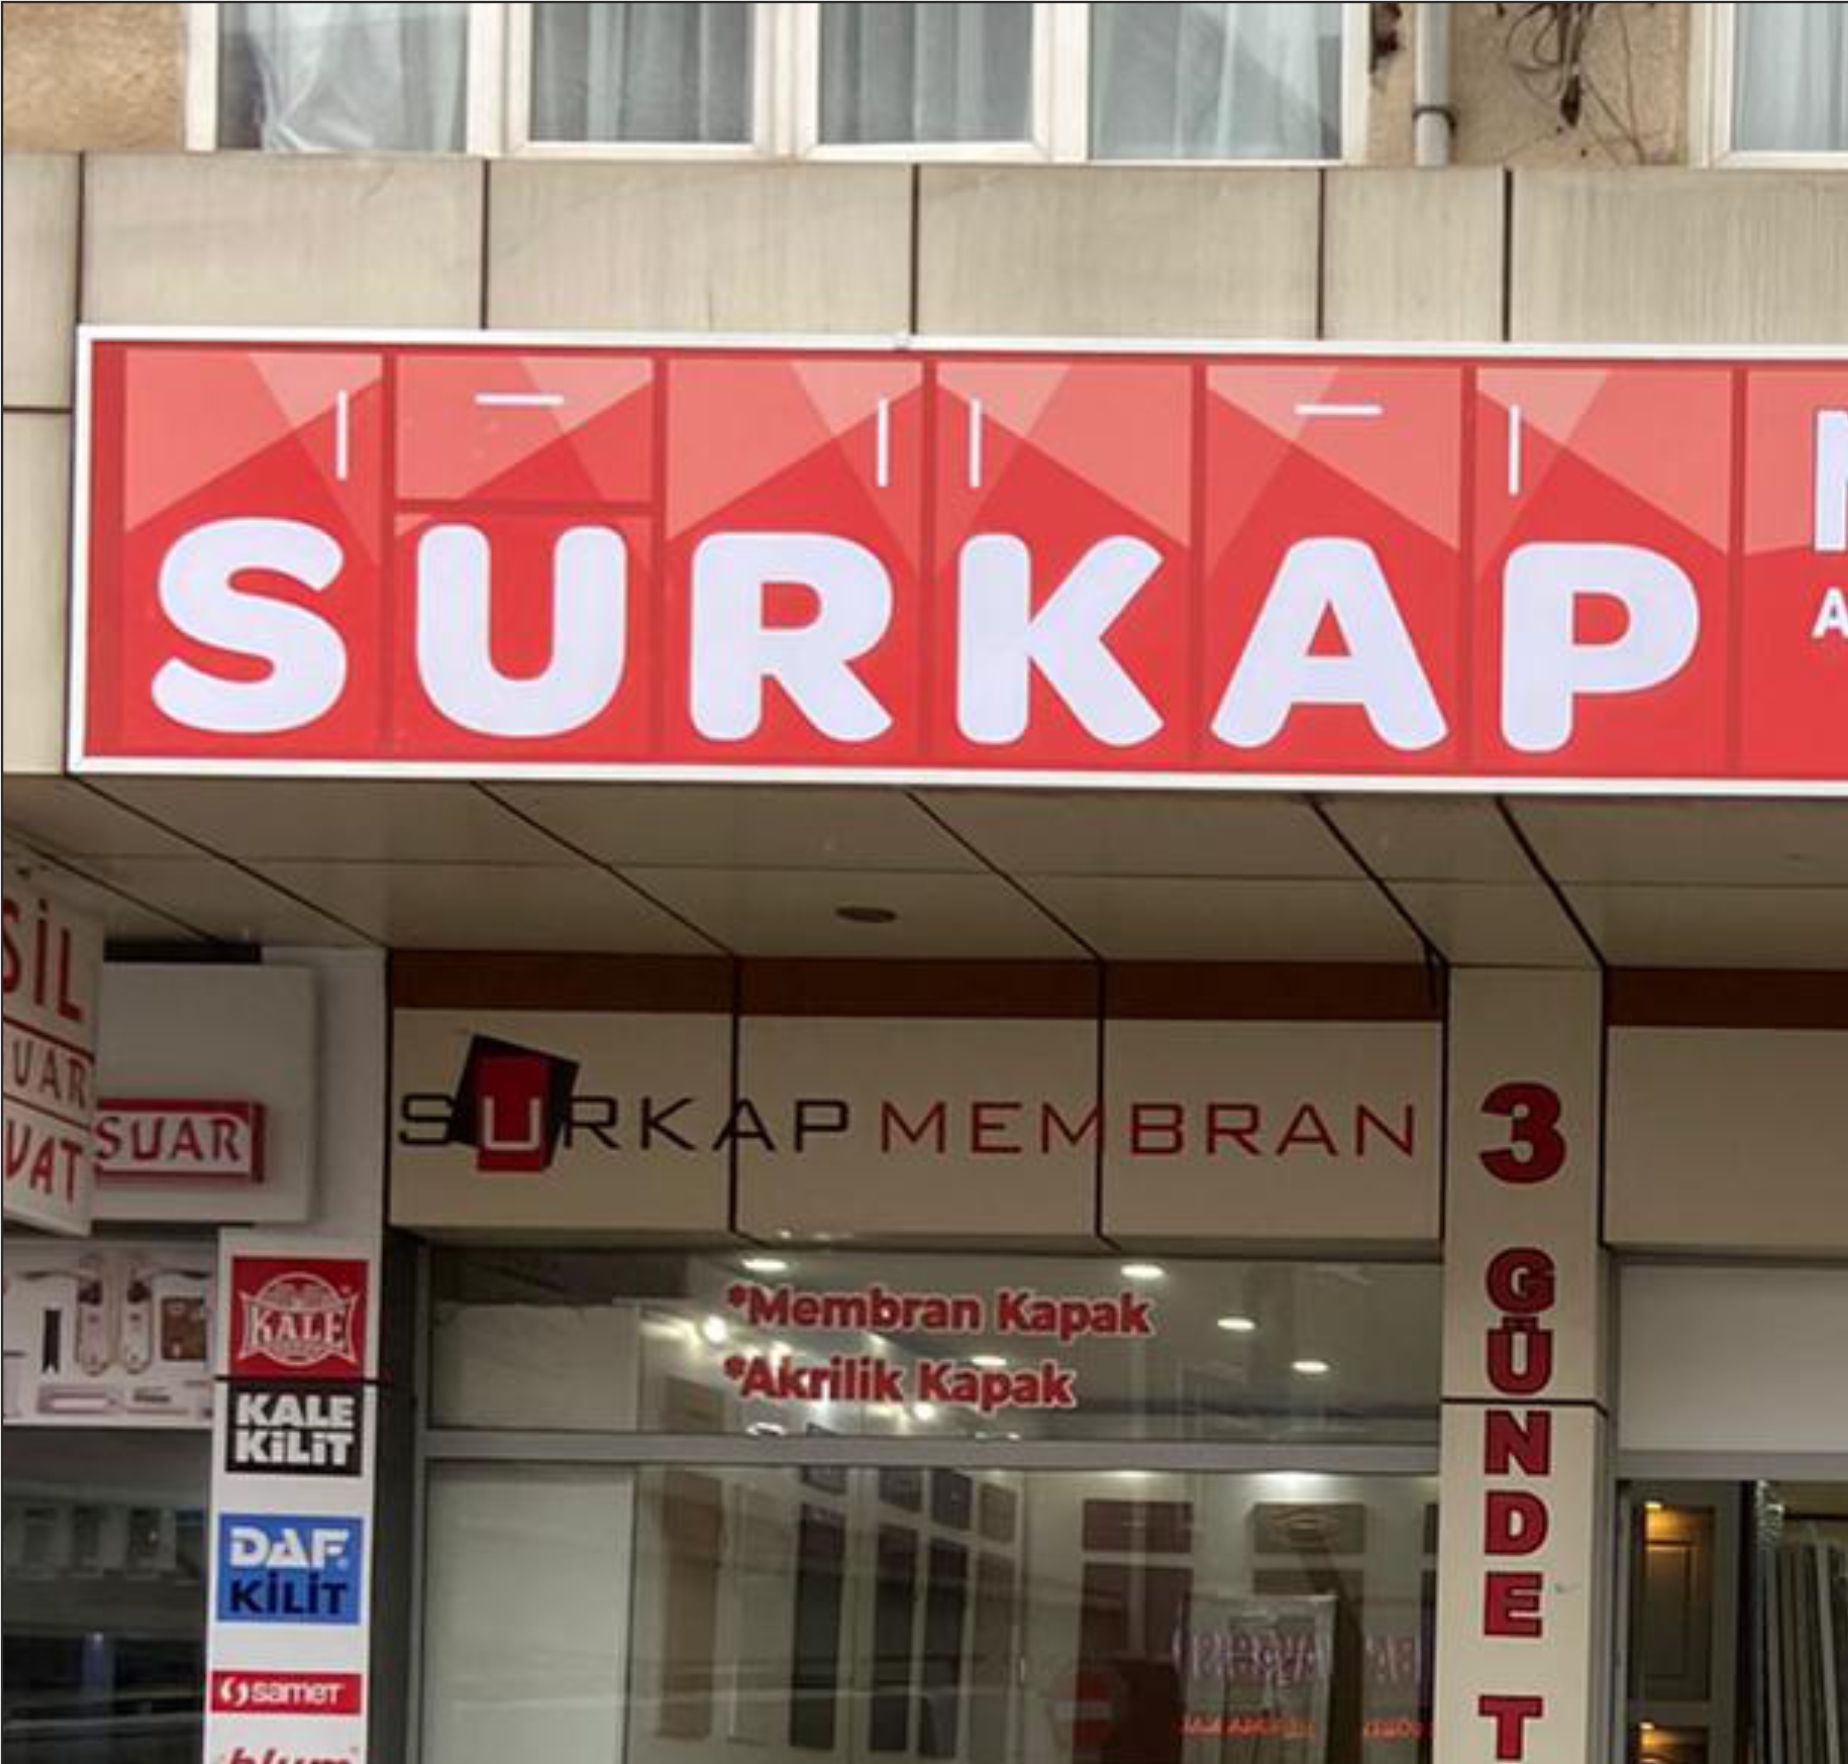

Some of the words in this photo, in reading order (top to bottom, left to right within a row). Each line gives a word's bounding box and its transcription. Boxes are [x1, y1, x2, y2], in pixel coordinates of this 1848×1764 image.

[150, 515, 1701, 755] SURKAP
[399, 1093, 850, 1154] SURKAP
[881, 1099, 1417, 1158] MEMBRAN
[1479, 1082, 1567, 1184] 3
[249, 1304, 347, 1350] KALE
[995, 1289, 1153, 1342] Kapak
[235, 1391, 355, 1429] KALE
[917, 1358, 1076, 1413] Kapak
[1483, 1246, 1556, 1638] GÜNDE
[229, 1526, 350, 1569] DAF
